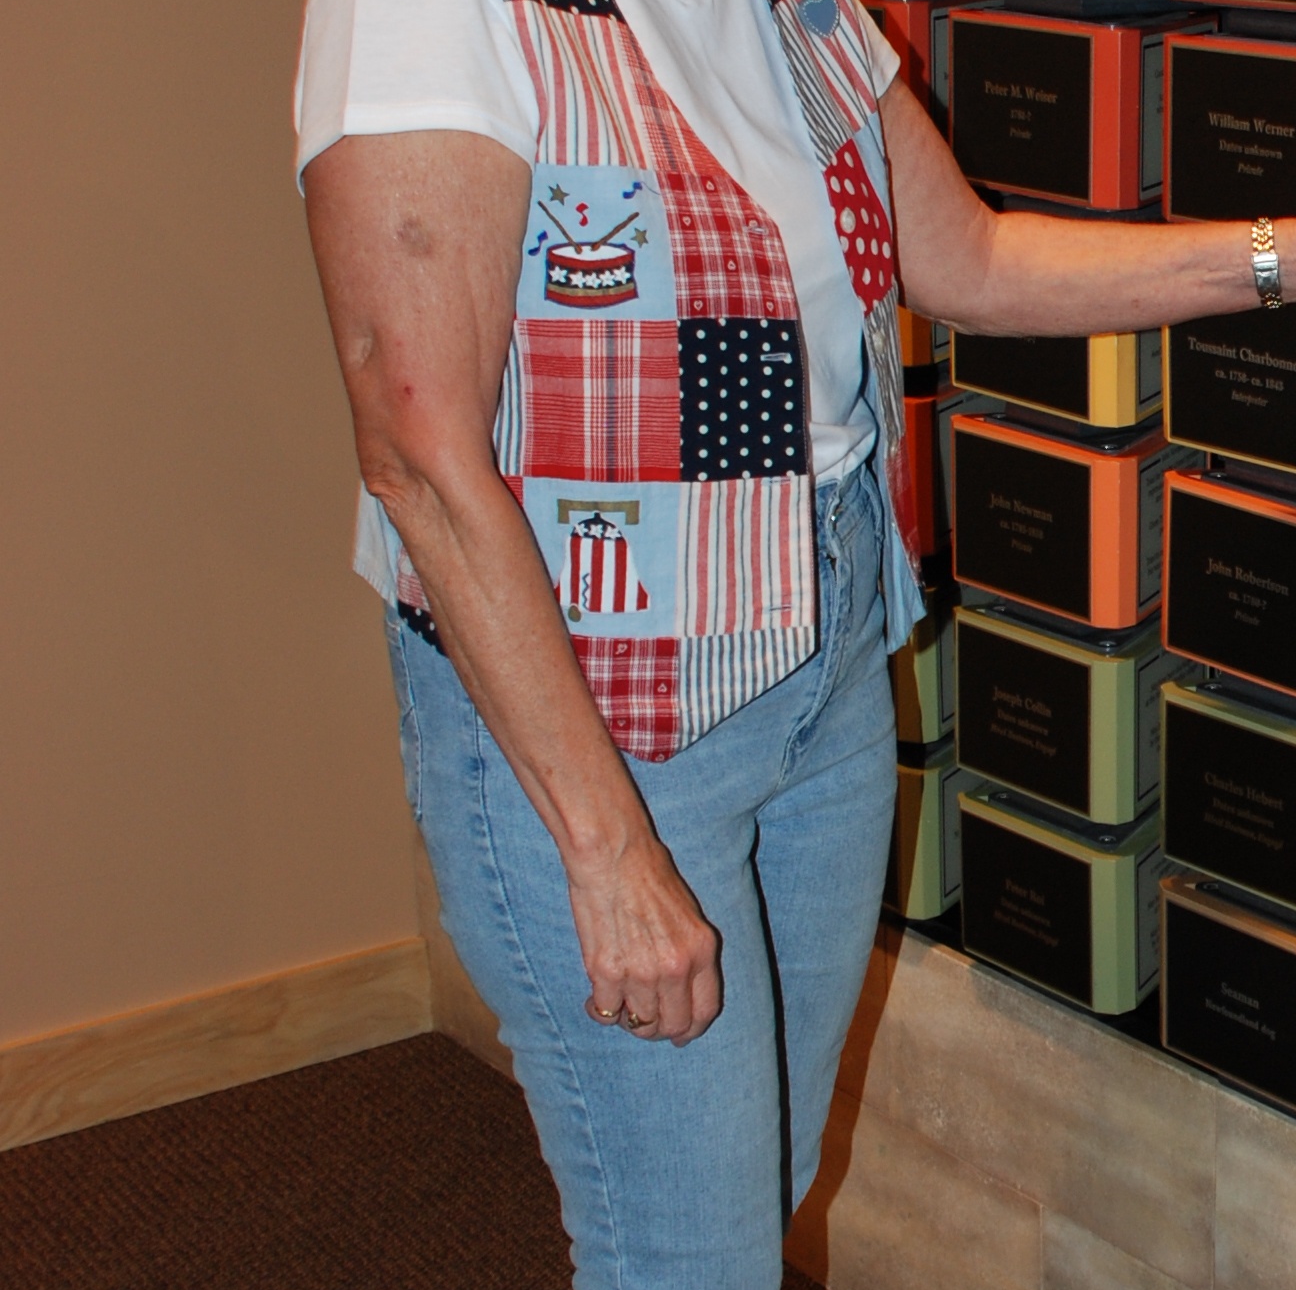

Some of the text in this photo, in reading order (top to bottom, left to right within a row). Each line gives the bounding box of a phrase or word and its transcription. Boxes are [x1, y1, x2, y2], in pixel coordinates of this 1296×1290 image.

[984, 80, 1008, 98] Peter
[1208, 111, 1296, 139] William Werner
[1219, 139, 1283, 160] Dates unknown
[1188, 336, 1238, 360] Toussaint
[1215, 368, 1227, 380] ca.
[1251, 375, 1263, 386] ca.
[990, 493, 1054, 523] John Newman
[1206, 557, 1290, 597] John Robertson
[1204, 771, 1245, 801] Charles
[1220, 981, 1260, 1010] Seaman
